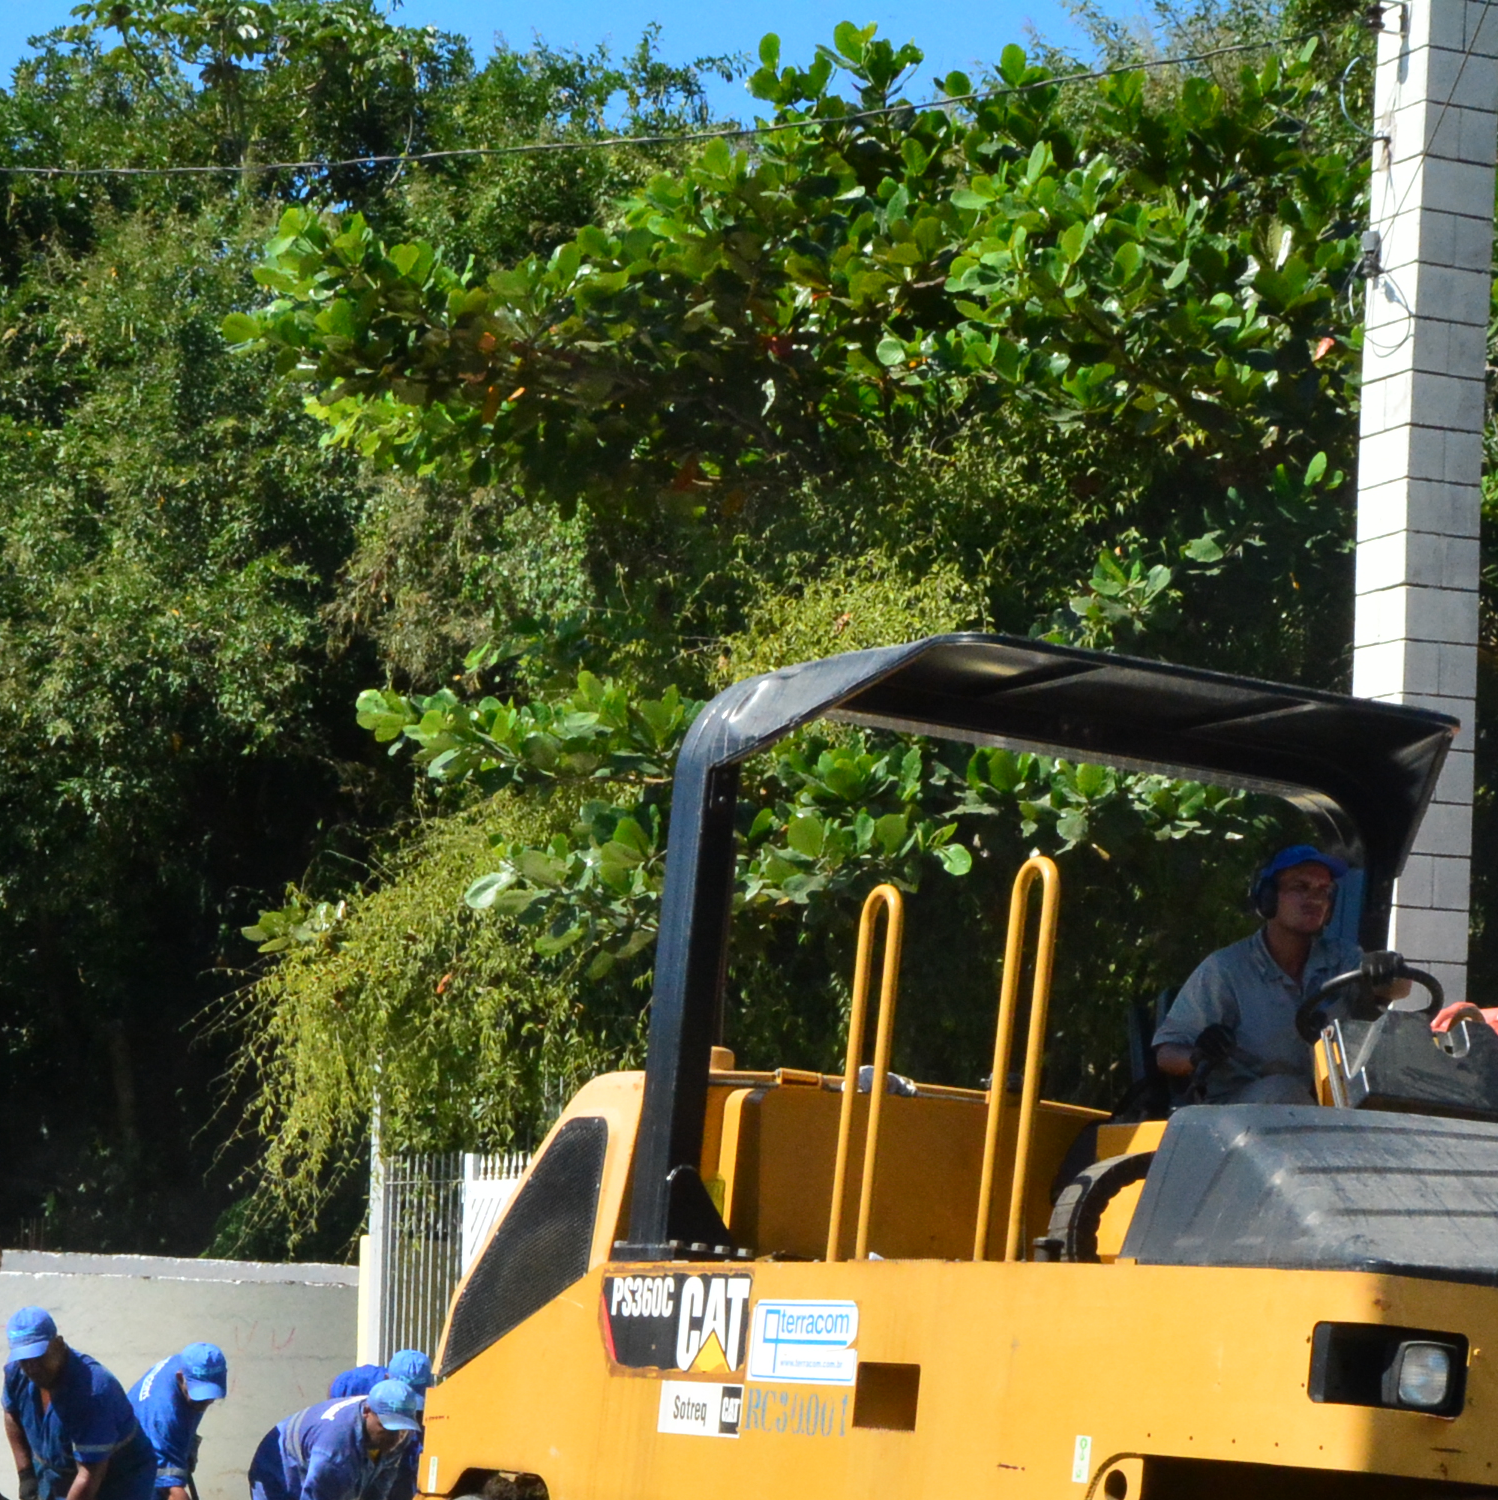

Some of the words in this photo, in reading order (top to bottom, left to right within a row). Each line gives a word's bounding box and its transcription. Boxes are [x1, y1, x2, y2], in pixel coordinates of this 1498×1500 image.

[611, 1276, 675, 1318] PS360C
[676, 1276, 751, 1372] CAT
[780, 1309, 850, 1334] terracom
[780, 1358, 843, 1369] www.terracom.com.br
[673, 1394, 707, 1426] Sotreq
[721, 1396, 741, 1423] CAT
